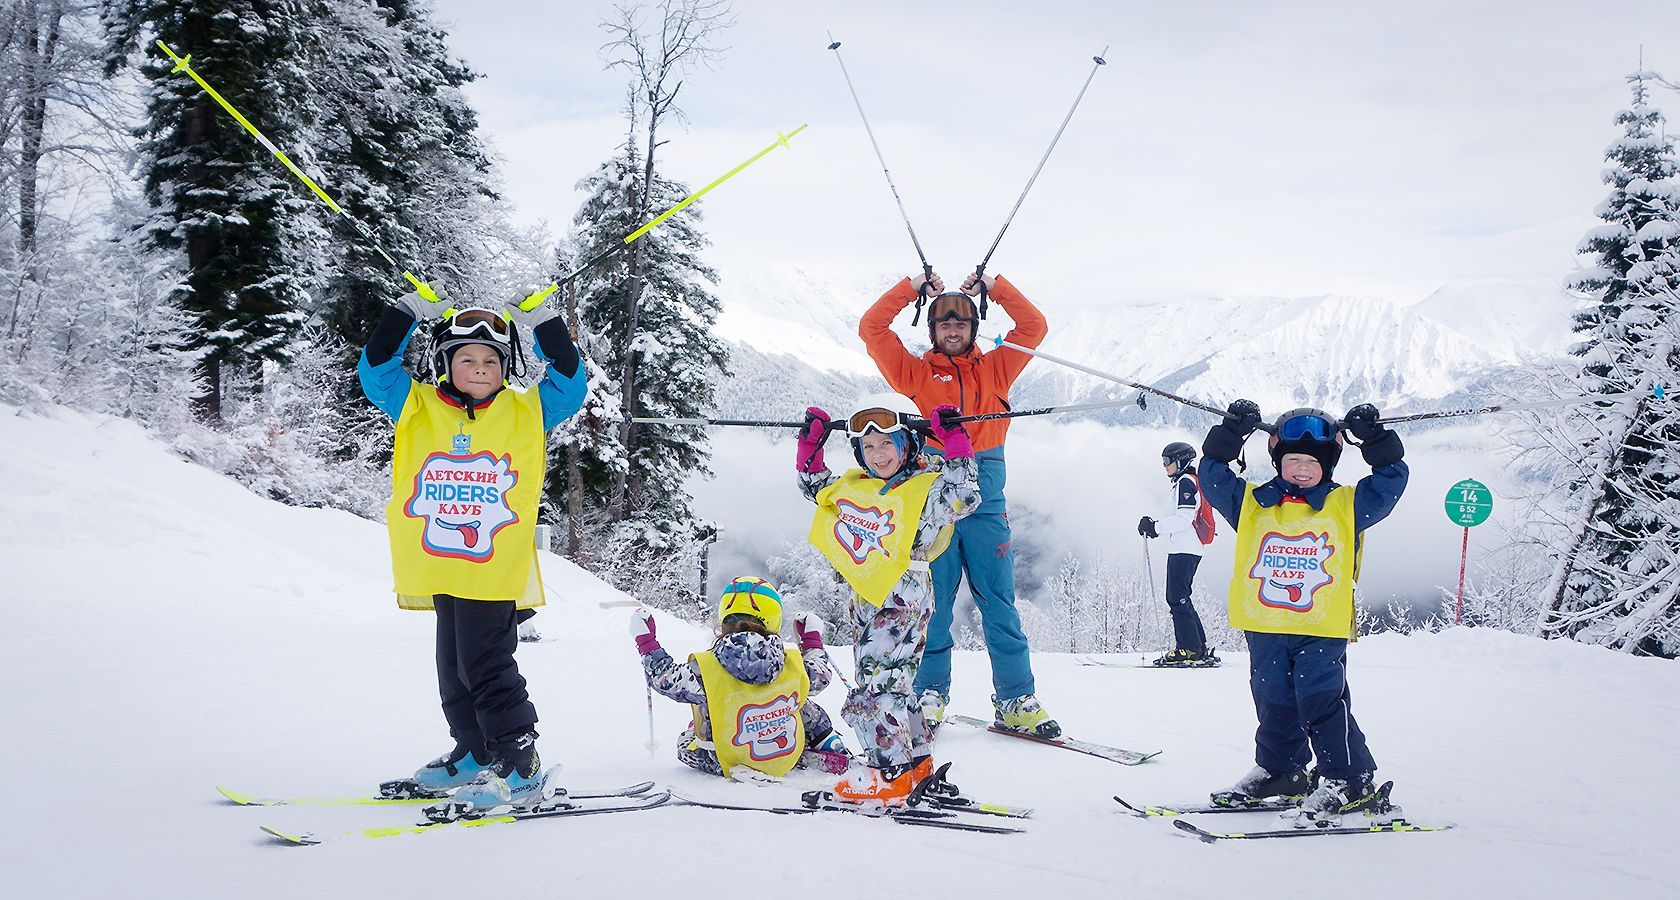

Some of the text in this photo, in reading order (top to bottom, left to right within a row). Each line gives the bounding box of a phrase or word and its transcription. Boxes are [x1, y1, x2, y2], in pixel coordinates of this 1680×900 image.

[424, 469, 499, 484] ДЕТСКИЙ
[425, 484, 499, 504] RIDERS
[1461, 490, 1478, 503] 14
[437, 503, 482, 516] КЛУБ
[1466, 505, 1476, 514] 52
[841, 513, 880, 531] ЕТСКИЙ
[1264, 545, 1318, 556] ДЕТСКИЙ
[1263, 555, 1319, 570] RIDERS
[1272, 569, 1305, 579] КЛУБ
